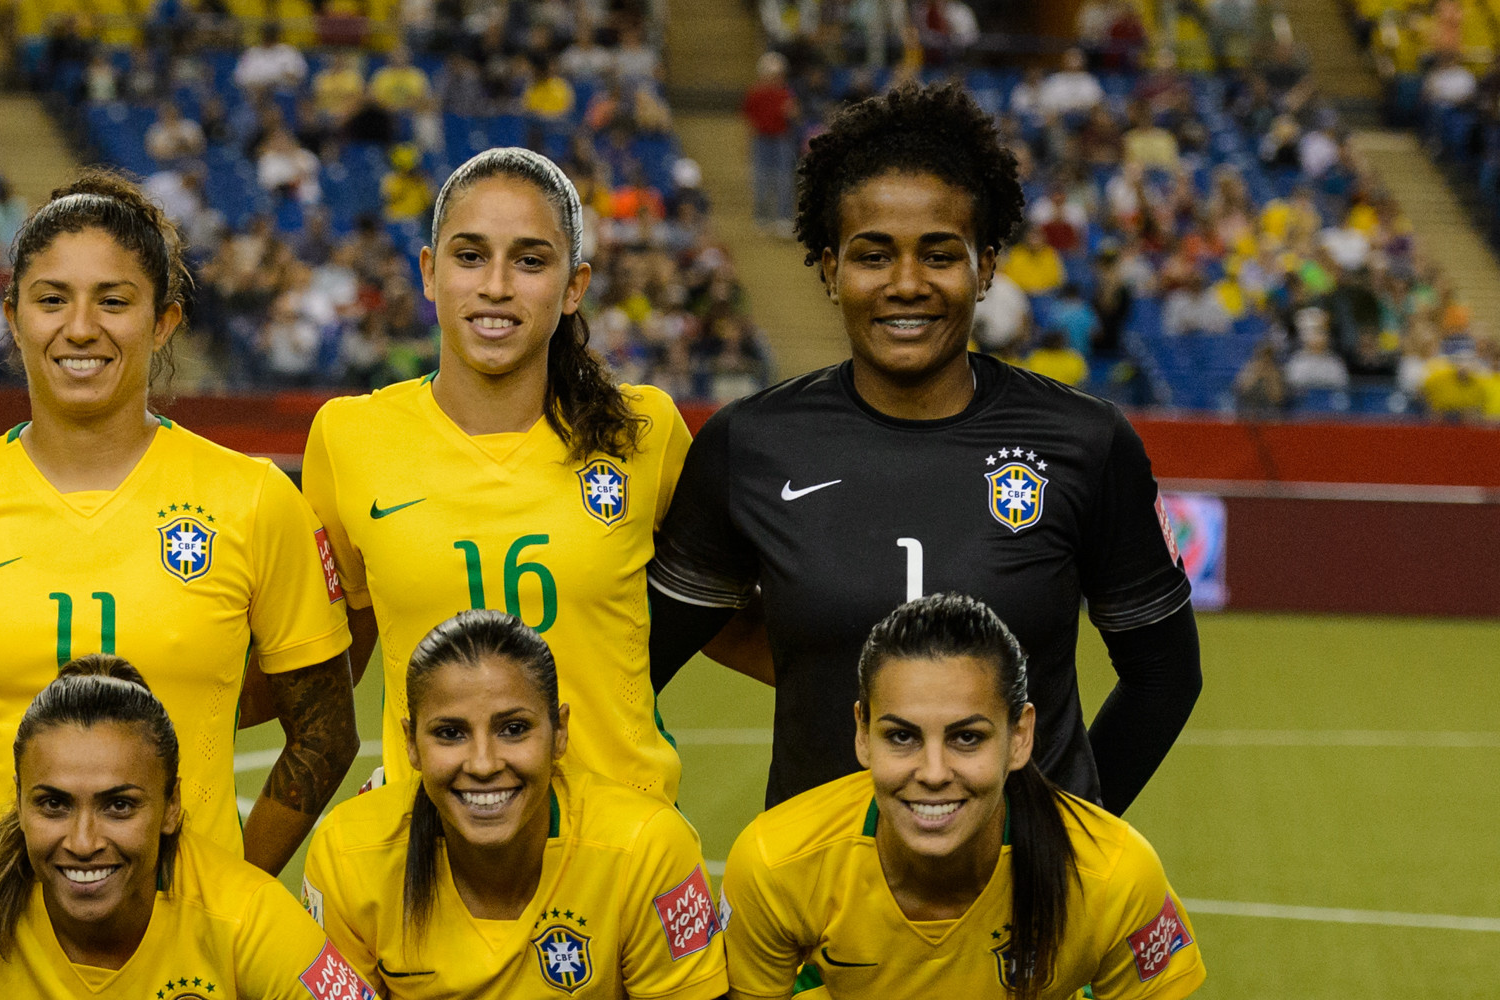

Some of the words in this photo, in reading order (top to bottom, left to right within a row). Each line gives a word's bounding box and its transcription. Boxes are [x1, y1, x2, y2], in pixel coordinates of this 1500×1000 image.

[597, 485, 614, 493] CBF
[1007, 490, 1026, 498] CBF
[453, 533, 558, 634] 16
[897, 537, 923, 603] 1
[49, 591, 116, 667] 11
[667, 883, 697, 922] LIVE
[670, 892, 707, 934] YOUR
[674, 899, 711, 949] GOALS
[315, 954, 338, 994] LIVE
[555, 953, 573, 961] CBF
